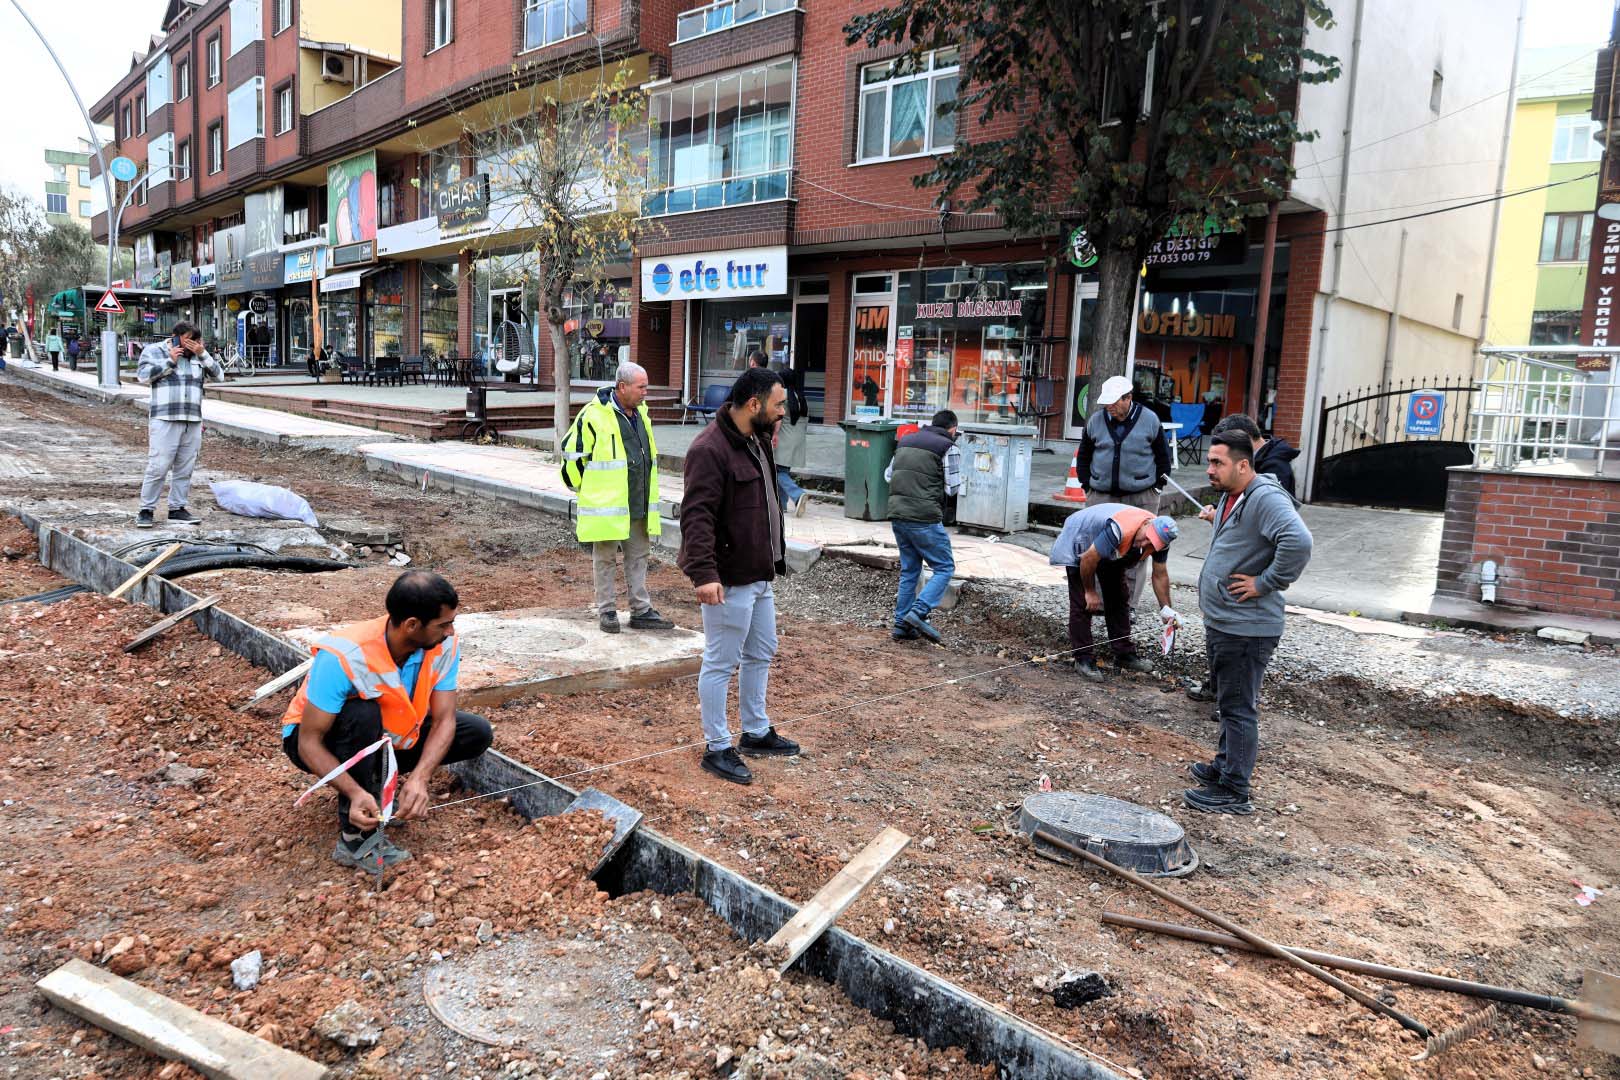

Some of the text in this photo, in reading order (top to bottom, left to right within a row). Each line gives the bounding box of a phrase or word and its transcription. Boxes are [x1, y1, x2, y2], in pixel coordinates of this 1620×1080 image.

[1181, 253, 1195, 261] 00
[1197, 251, 1210, 261] 79
[680, 260, 768, 293] efe tur
[915, 303, 954, 319] KUZU
